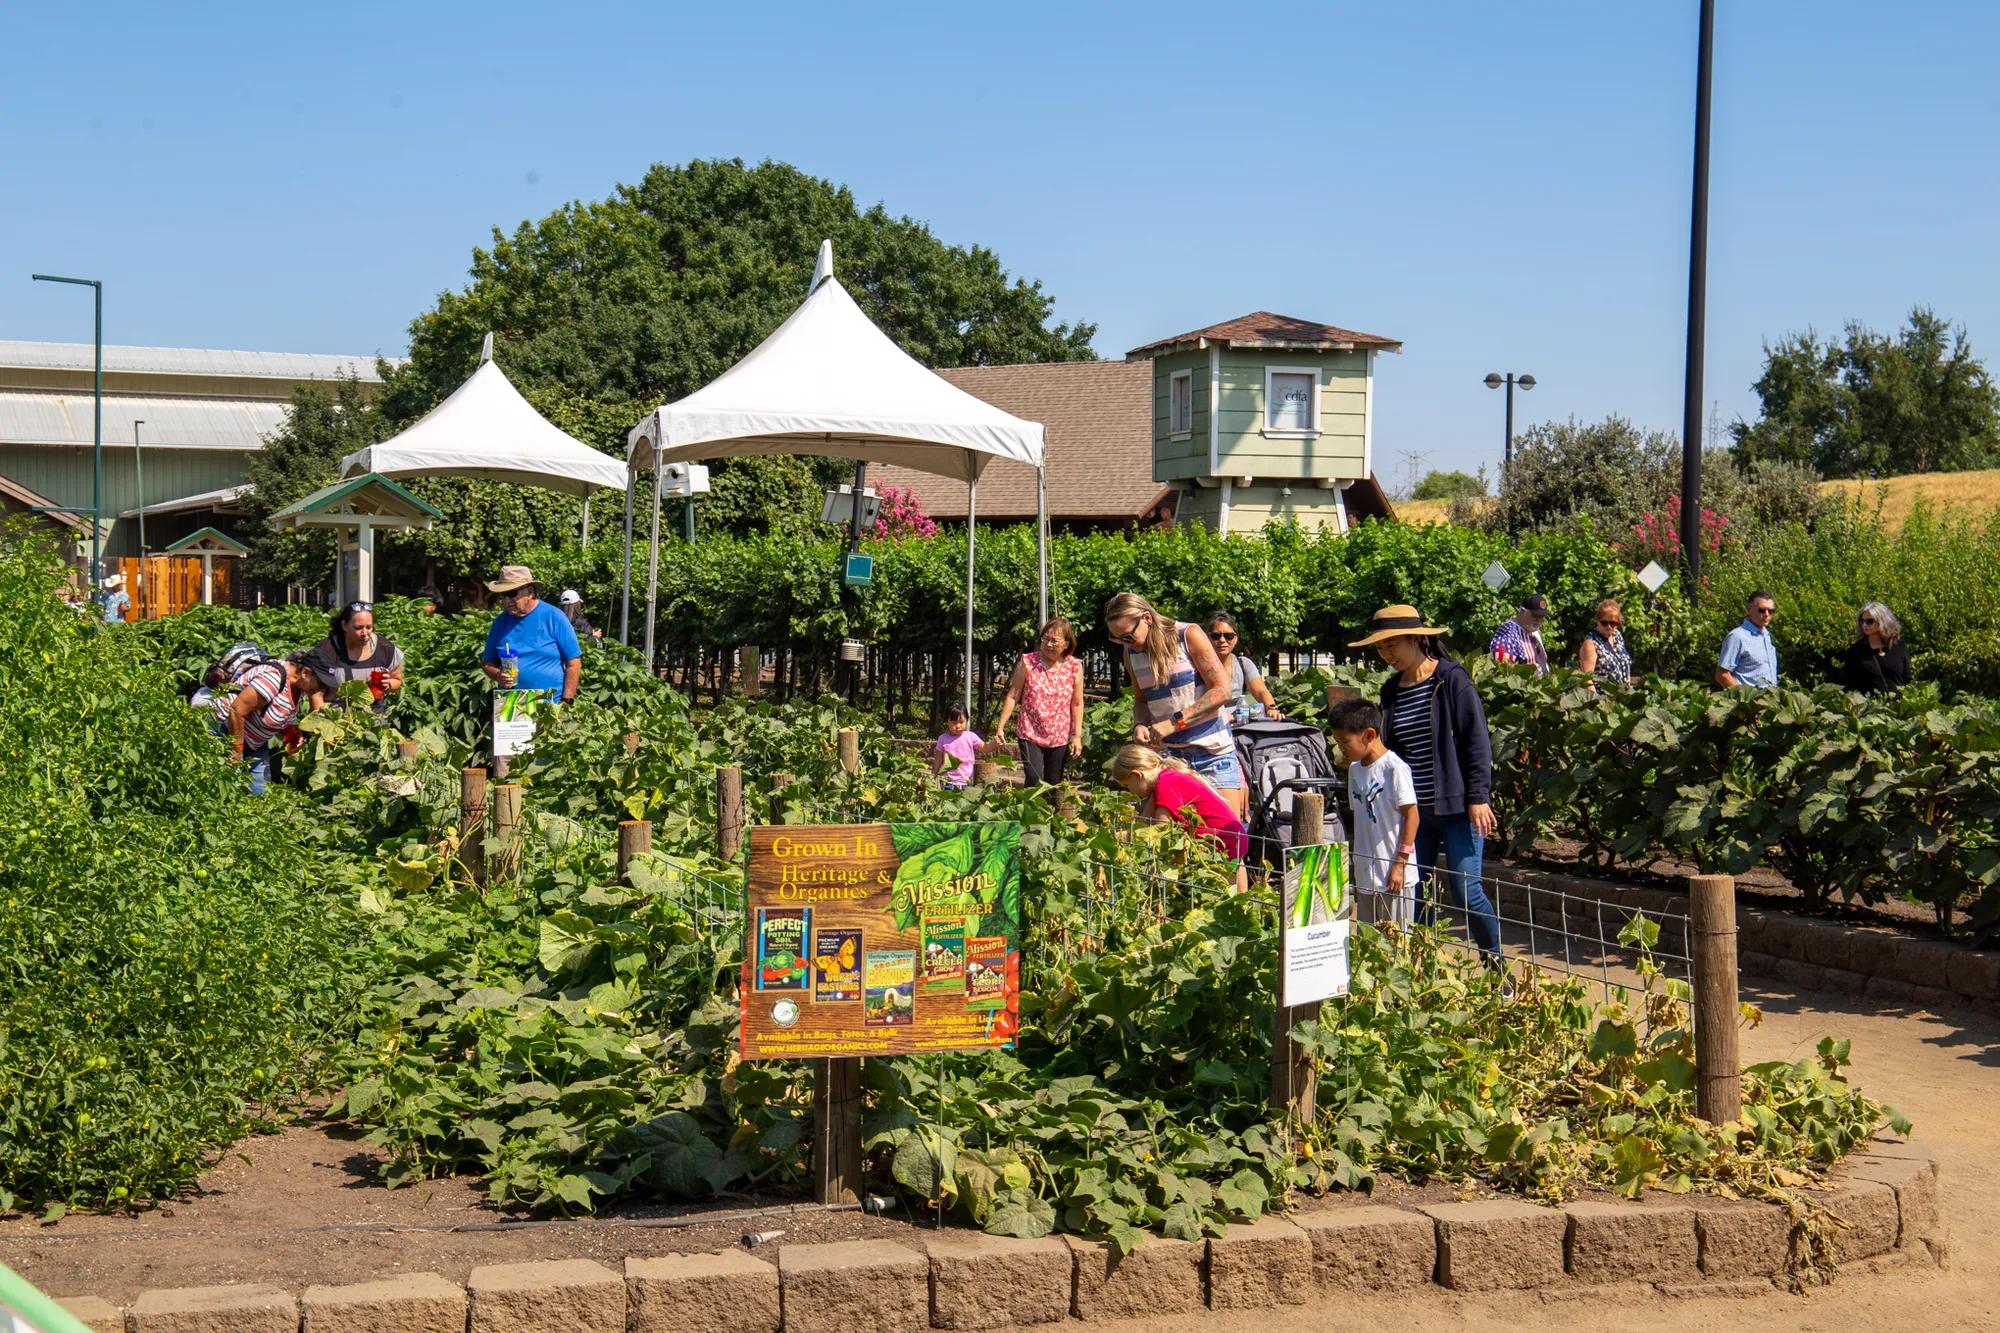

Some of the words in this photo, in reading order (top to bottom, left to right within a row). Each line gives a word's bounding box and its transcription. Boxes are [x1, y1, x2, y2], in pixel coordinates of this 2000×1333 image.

[773, 836, 847, 857] Grown
[855, 836, 878, 857] In
[781, 864, 869, 885] Heritage
[877, 870, 892, 884] &
[780, 882, 868, 903] Organics
[896, 872, 997, 912] Mission
[915, 903, 993, 916] FERTILIZER
[761, 918, 808, 934] PERFECT
[925, 922, 964, 938] Mission
[965, 940, 1006, 958] Mission
[926, 1014, 966, 1025] Available
[756, 1031, 800, 1041] Available
